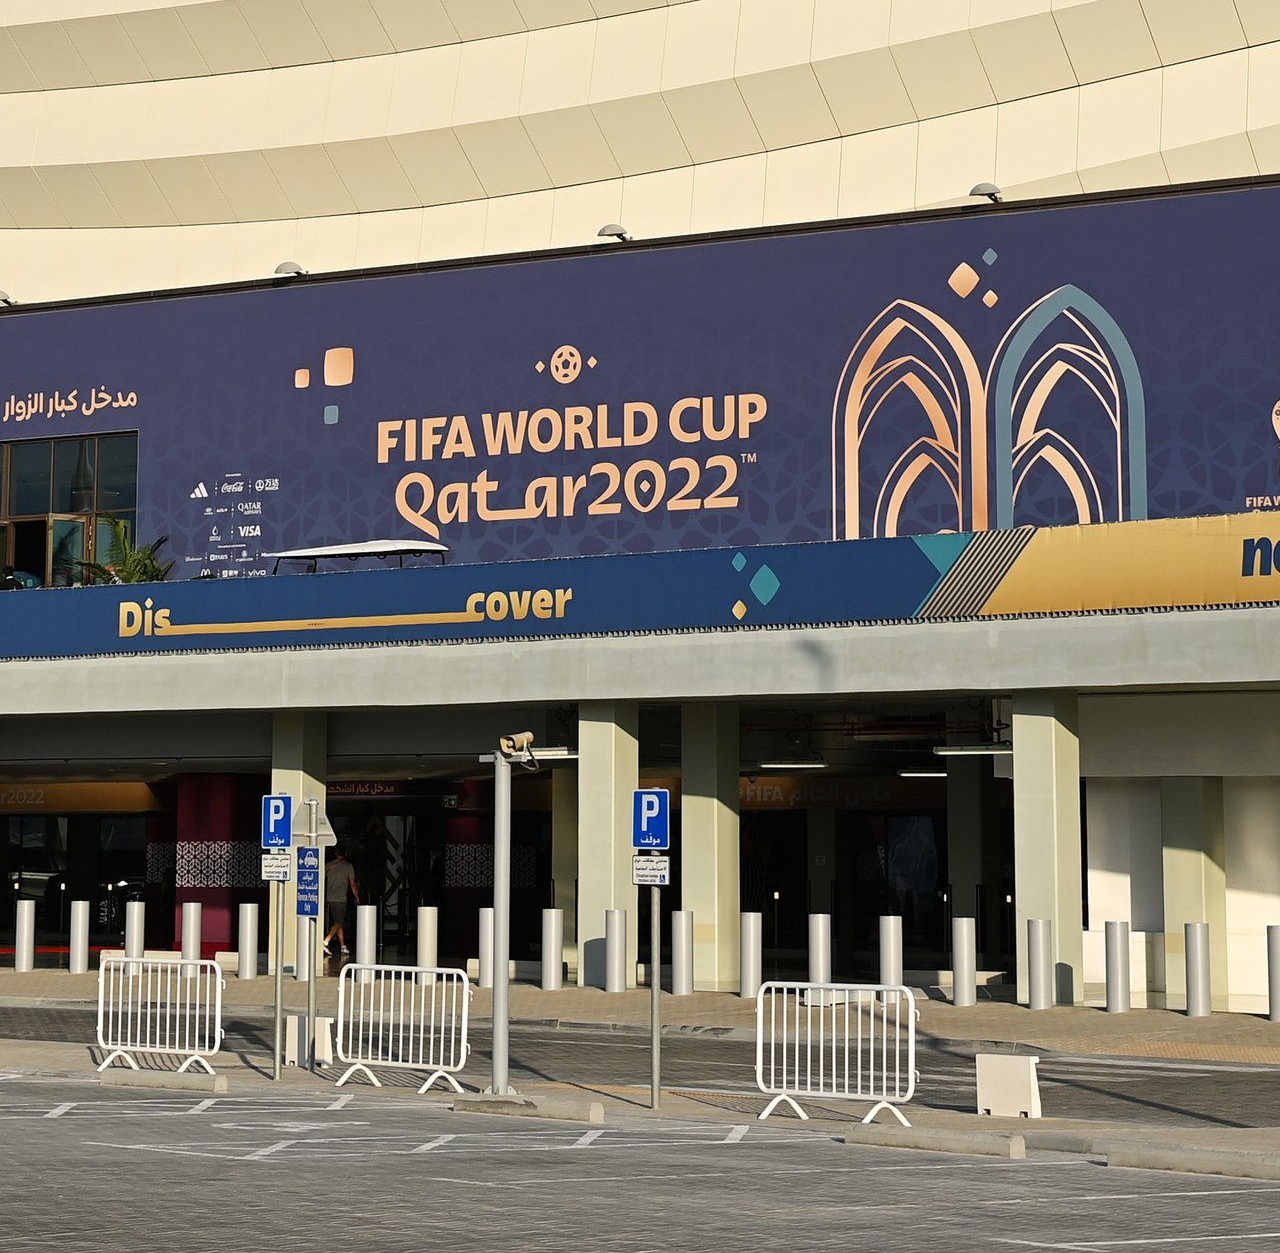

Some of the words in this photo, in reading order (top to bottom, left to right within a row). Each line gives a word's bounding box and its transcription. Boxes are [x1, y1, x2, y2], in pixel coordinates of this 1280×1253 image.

[3, 392, 44, 422] الزوار
[47, 389, 78, 418] كبار
[81, 385, 138, 416] مدخل
[377, 415, 476, 463] FIFA
[482, 401, 659, 457] WORLD
[668, 393, 768, 444] CUP
[237, 502, 262, 511] QATAR
[1245, 496, 1271, 508] FIFA
[238, 525, 262, 537] VISA
[247, 568, 266, 576] vivo
[746, 785, 784, 802] FIFA
[269, 799, 285, 833] P
[641, 794, 659, 831] P
[268, 834, 285, 846] موقف
[640, 832, 660, 845] موقف
